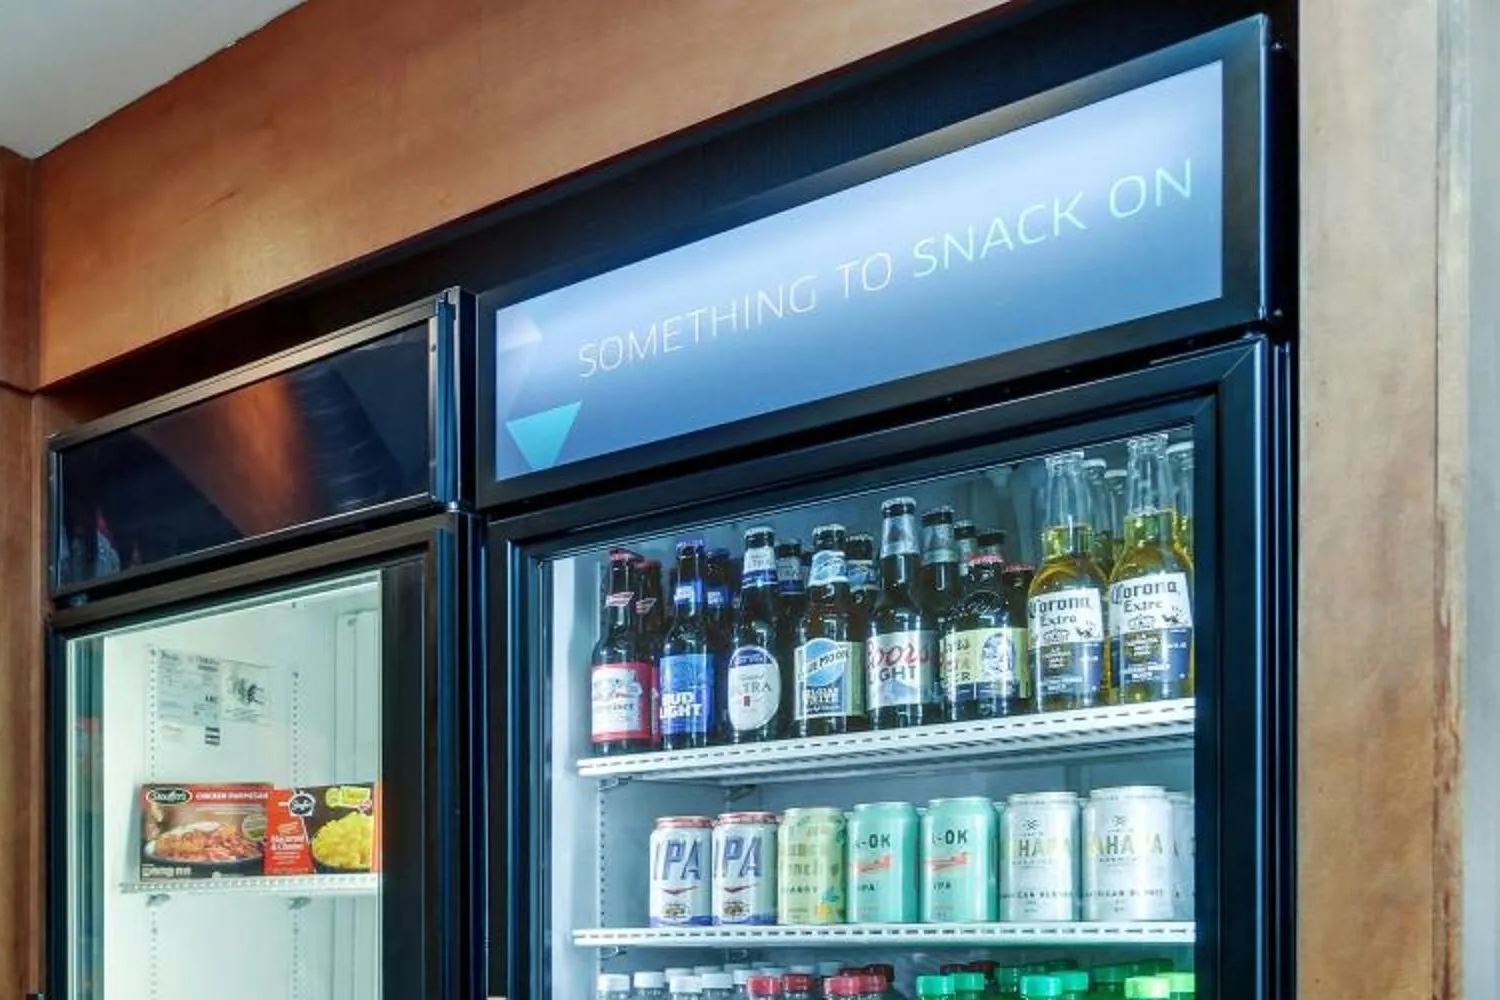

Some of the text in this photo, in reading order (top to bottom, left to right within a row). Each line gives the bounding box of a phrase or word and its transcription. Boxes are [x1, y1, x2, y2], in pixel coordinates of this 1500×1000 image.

[576, 157, 1193, 380] SOMETHING TO SNACK ON
[1111, 579, 1178, 604] Corona
[1029, 597, 1093, 619] Corona
[1124, 598, 1163, 612] Extra
[1041, 614, 1077, 627] Extra
[856, 834, 891, 849] -OK
[933, 829, 968, 846] -OK
[654, 839, 700, 880] IPA
[714, 835, 762, 880] IPA
